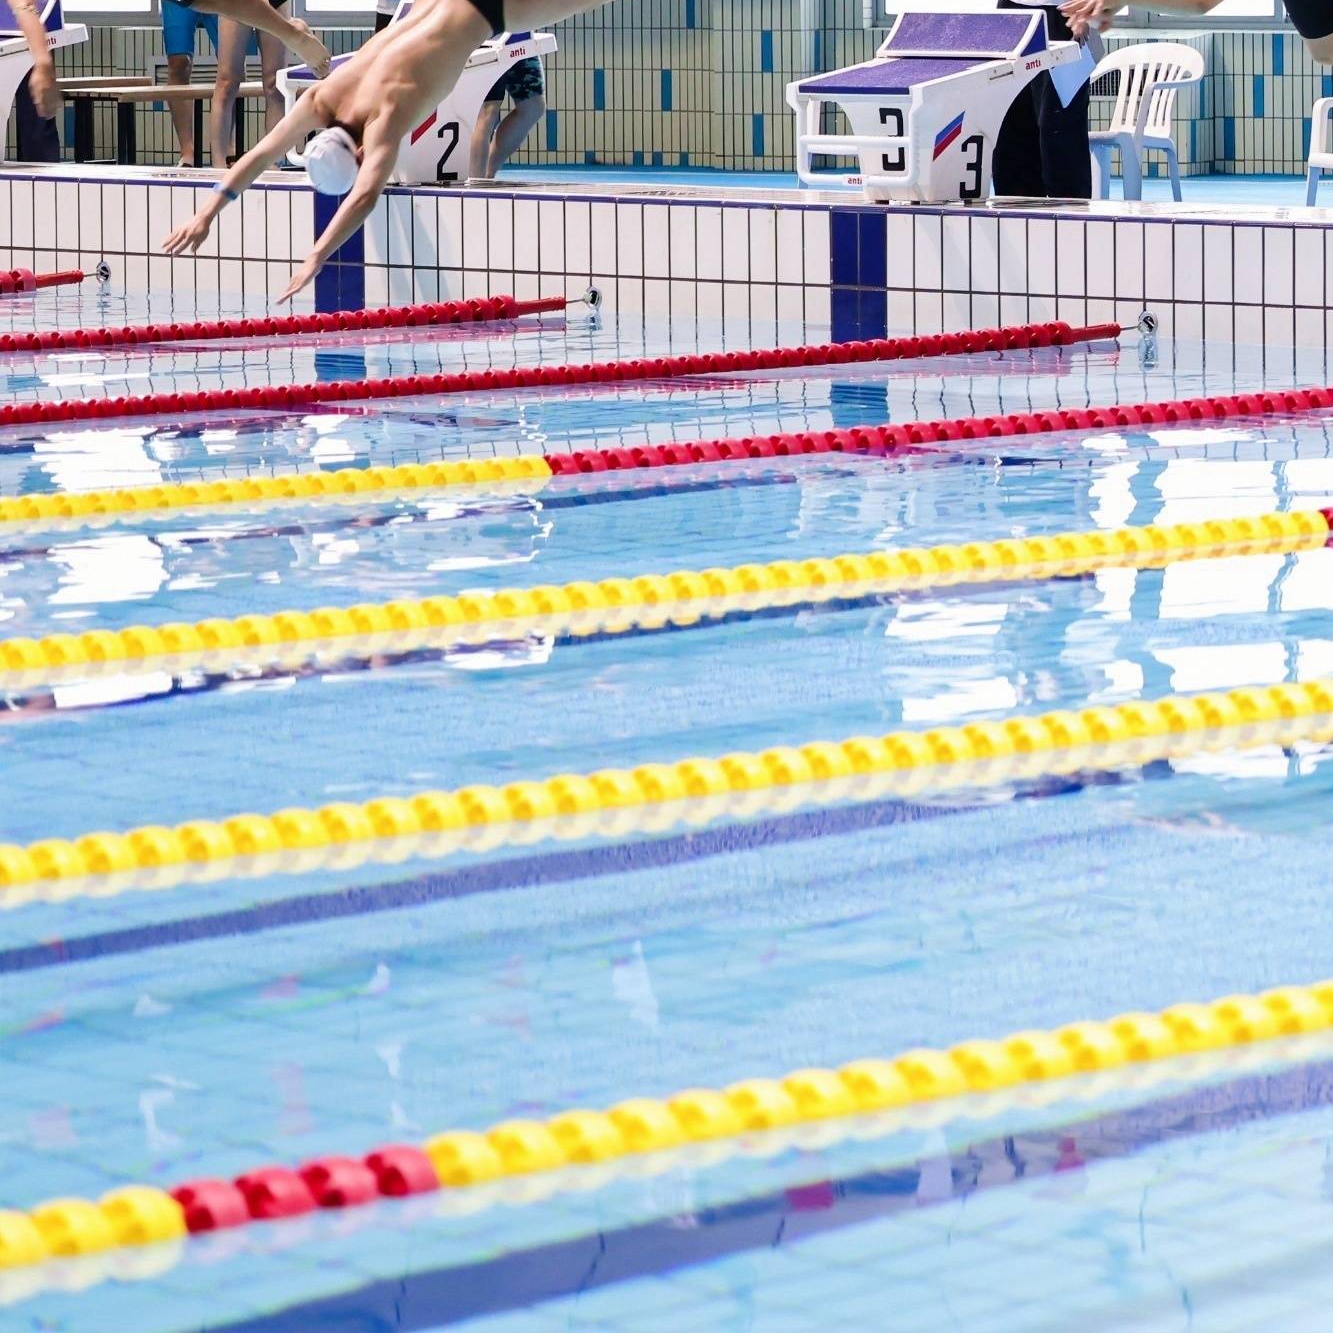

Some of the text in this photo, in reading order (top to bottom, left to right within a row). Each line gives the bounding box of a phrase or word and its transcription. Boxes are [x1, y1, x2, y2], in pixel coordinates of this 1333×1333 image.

[509, 46, 527, 58] anti
[1025, 58, 1042, 71] anti
[436, 121, 459, 181] 2
[879, 107, 906, 172] 3
[847, 176, 863, 185] anti
[959, 135, 984, 200] 3
